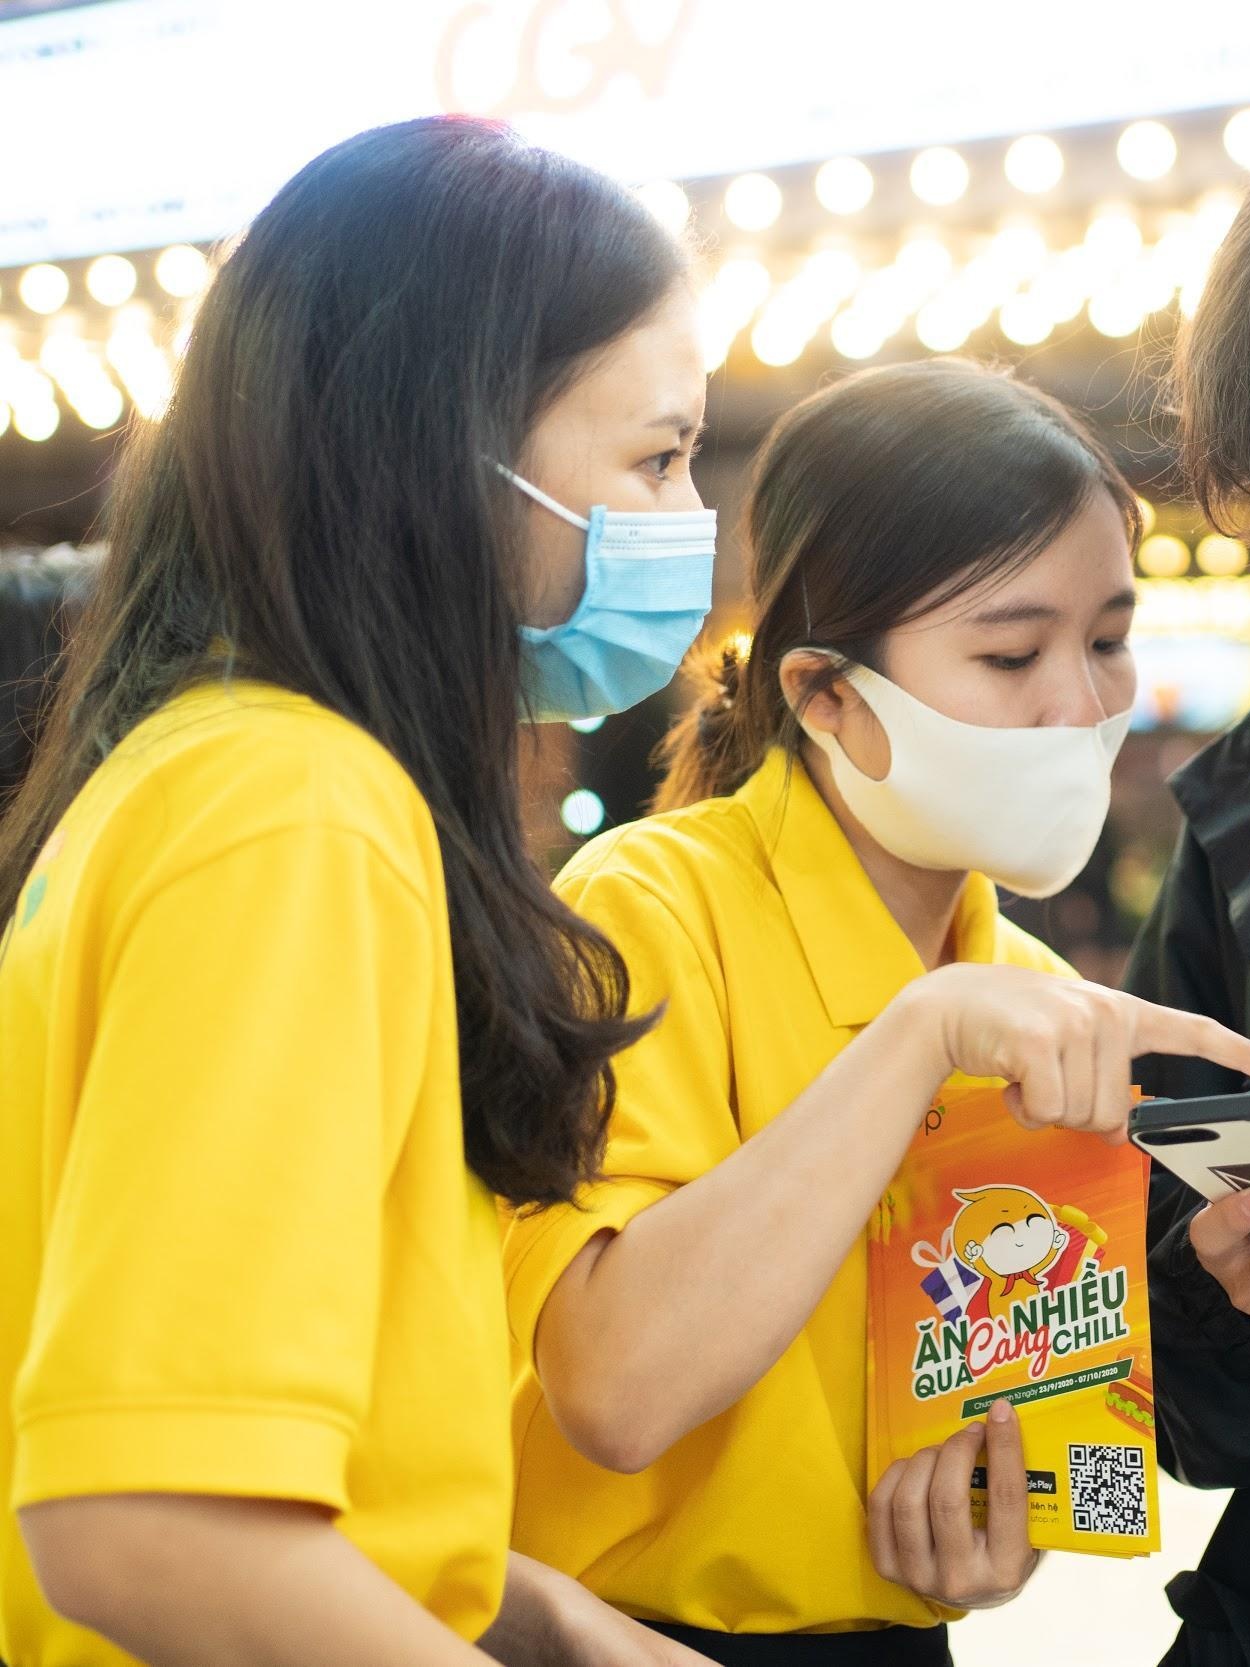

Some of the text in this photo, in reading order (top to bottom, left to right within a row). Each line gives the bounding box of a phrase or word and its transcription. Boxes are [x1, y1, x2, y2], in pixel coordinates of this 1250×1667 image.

[434, 0, 704, 118] CGV
[916, 1262, 1125, 1370] ĂN NHIỀU
[966, 1319, 1050, 1377] Càng
[914, 1312, 1127, 1398] QUÀ CHILL
[1038, 1378, 1074, 1394] 23/9/2020
[1078, 1367, 1118, 1383] 07/10/2020
[1037, 1480, 1053, 1491] Play
